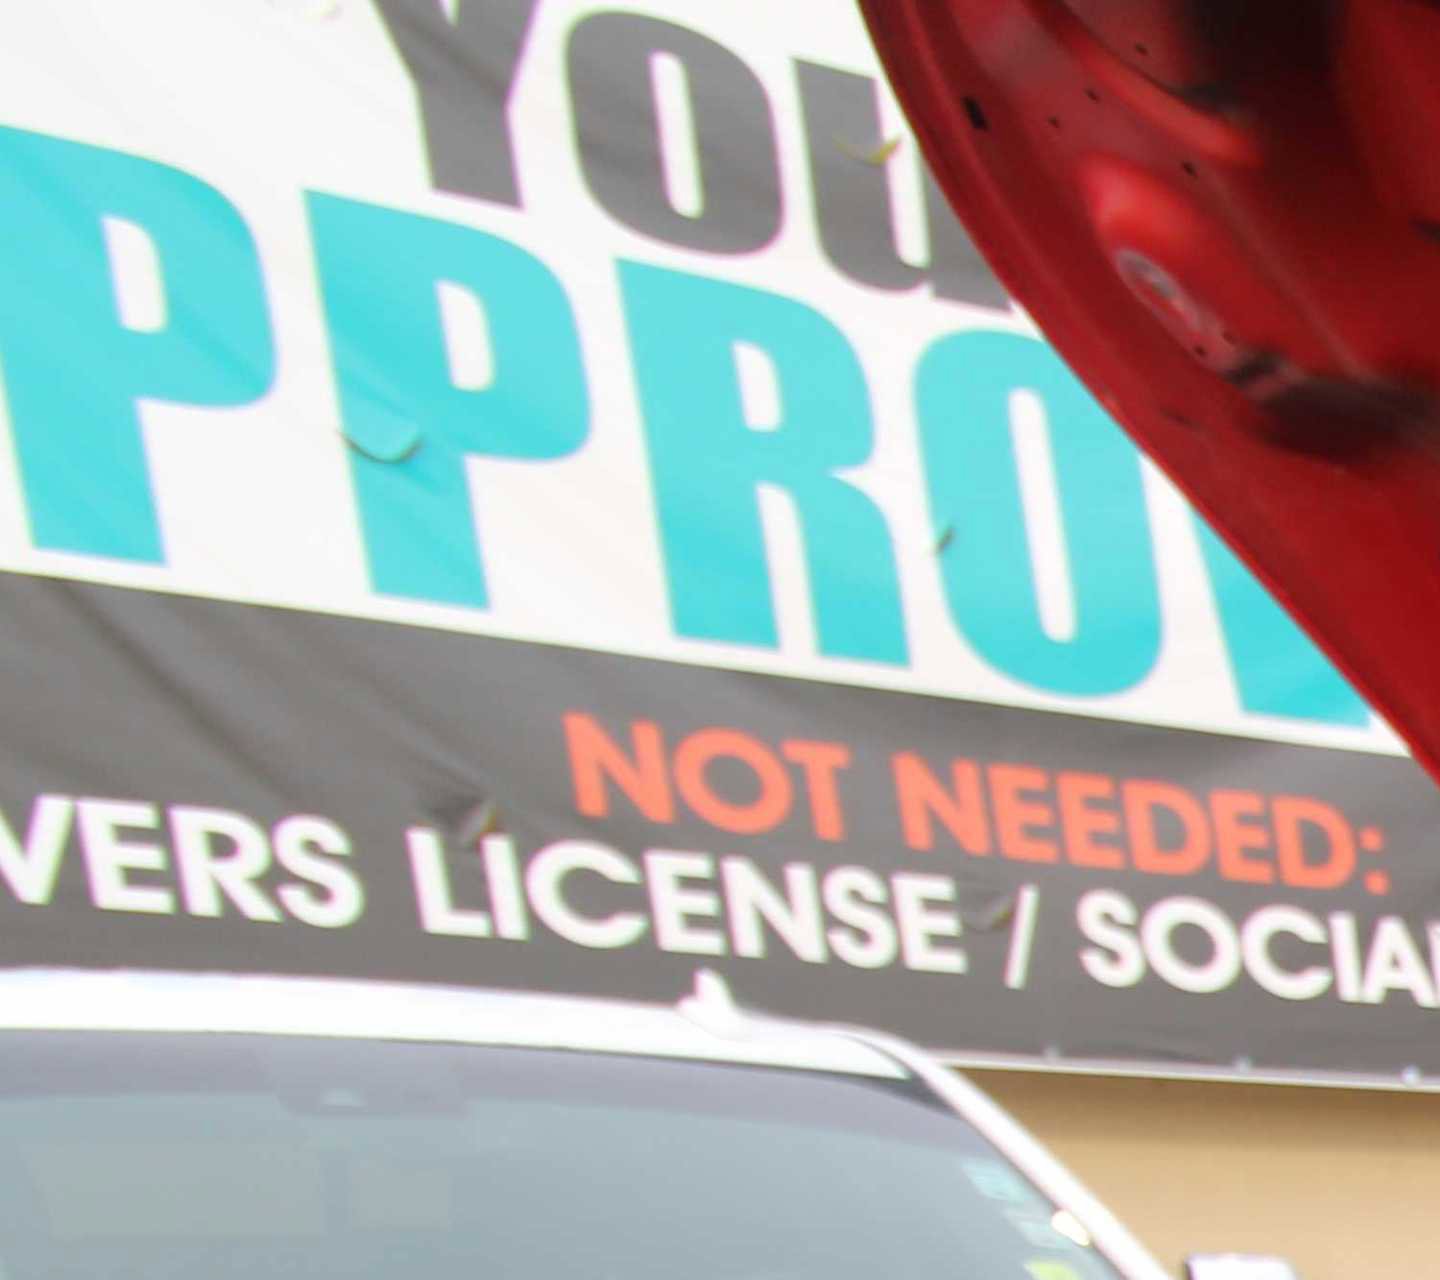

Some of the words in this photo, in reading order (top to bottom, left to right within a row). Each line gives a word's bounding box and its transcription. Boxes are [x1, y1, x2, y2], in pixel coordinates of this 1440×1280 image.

[0, 793, 366, 928] VERS
[407, 826, 967, 974] LICENSE
[1004, 883, 1037, 989] /
[563, 710, 851, 842] NOT
[892, 751, 1390, 895] NEEDED:
